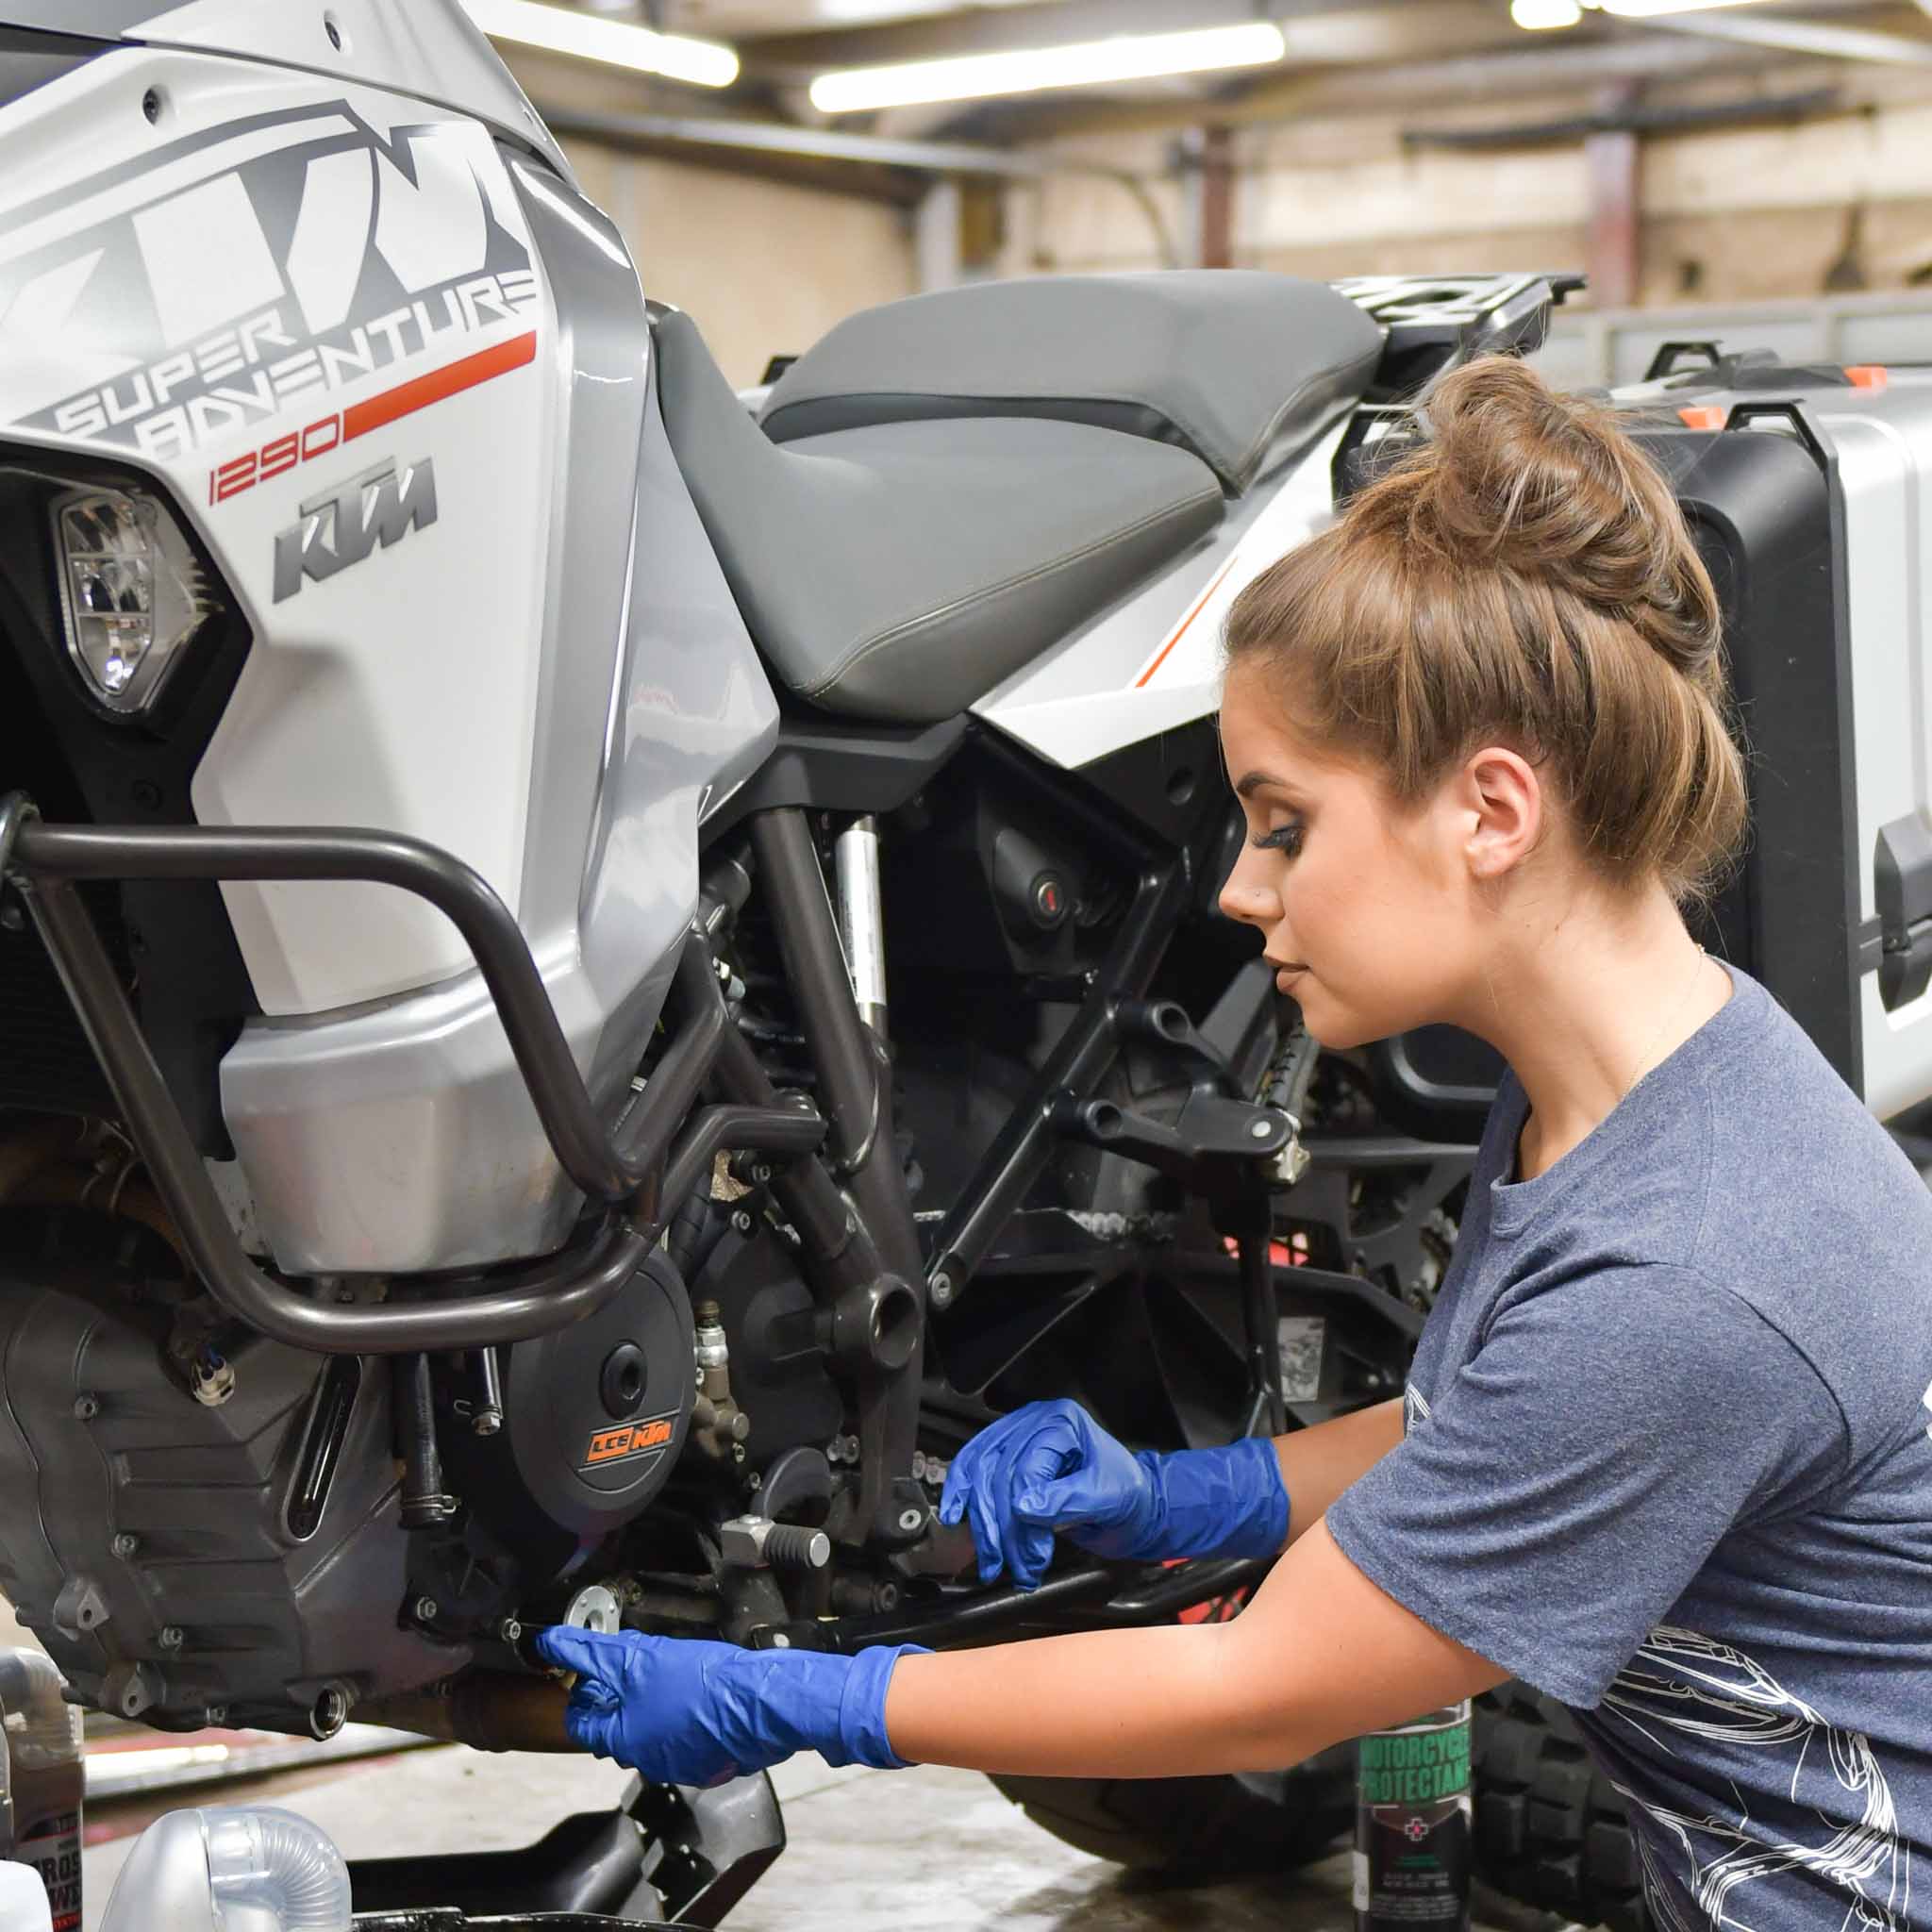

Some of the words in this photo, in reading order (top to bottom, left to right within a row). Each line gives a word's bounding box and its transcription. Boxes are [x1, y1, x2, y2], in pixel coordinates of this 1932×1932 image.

[54, 307, 297, 440] SUPER
[134, 270, 537, 458] ADVENTURE
[209, 413, 340, 506] 1290
[272, 455, 437, 605] KTM
[633, 1420, 671, 1450] KTM
